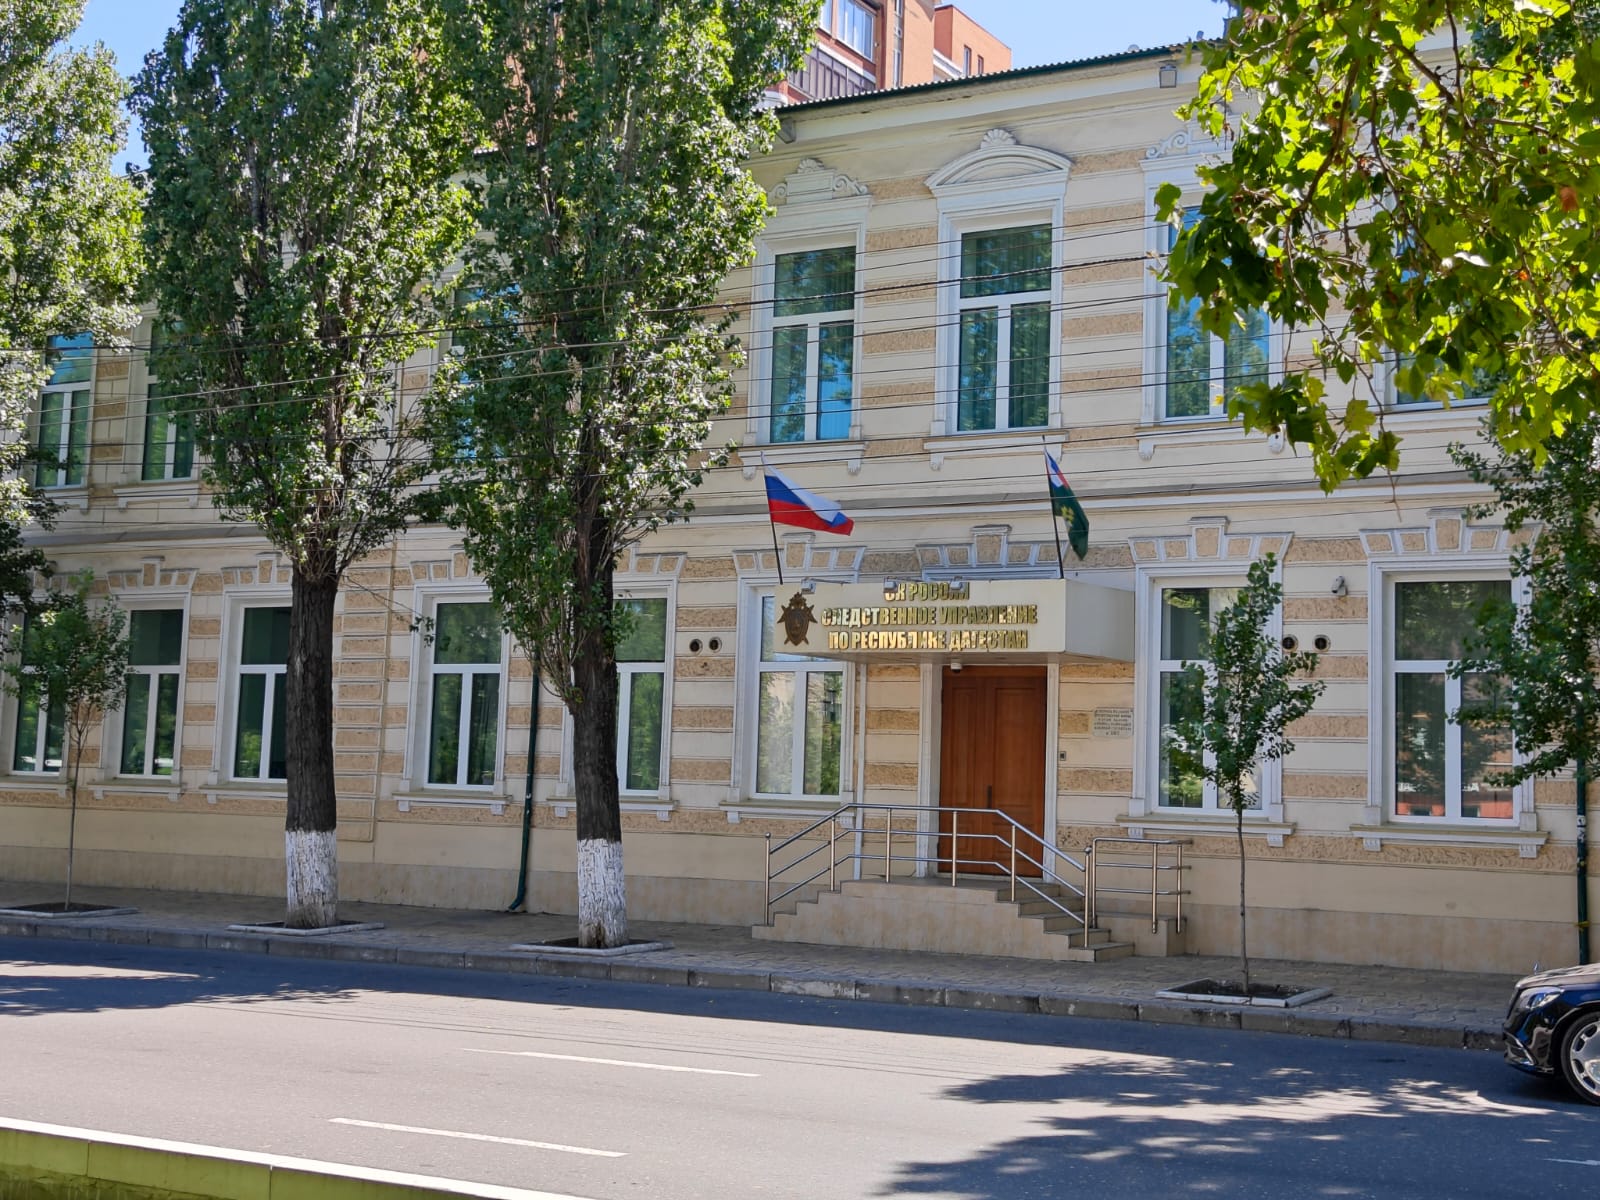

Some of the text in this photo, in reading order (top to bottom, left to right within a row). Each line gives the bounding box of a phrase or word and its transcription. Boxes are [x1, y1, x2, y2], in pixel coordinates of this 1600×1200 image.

[821, 605, 1038, 628] СЛЕДСТВЕННОЕ УПРАВЛЕНИЕ
[828, 630, 1028, 651] ПО РЕСПУБЛИКЕ ДАГЕСТАН
